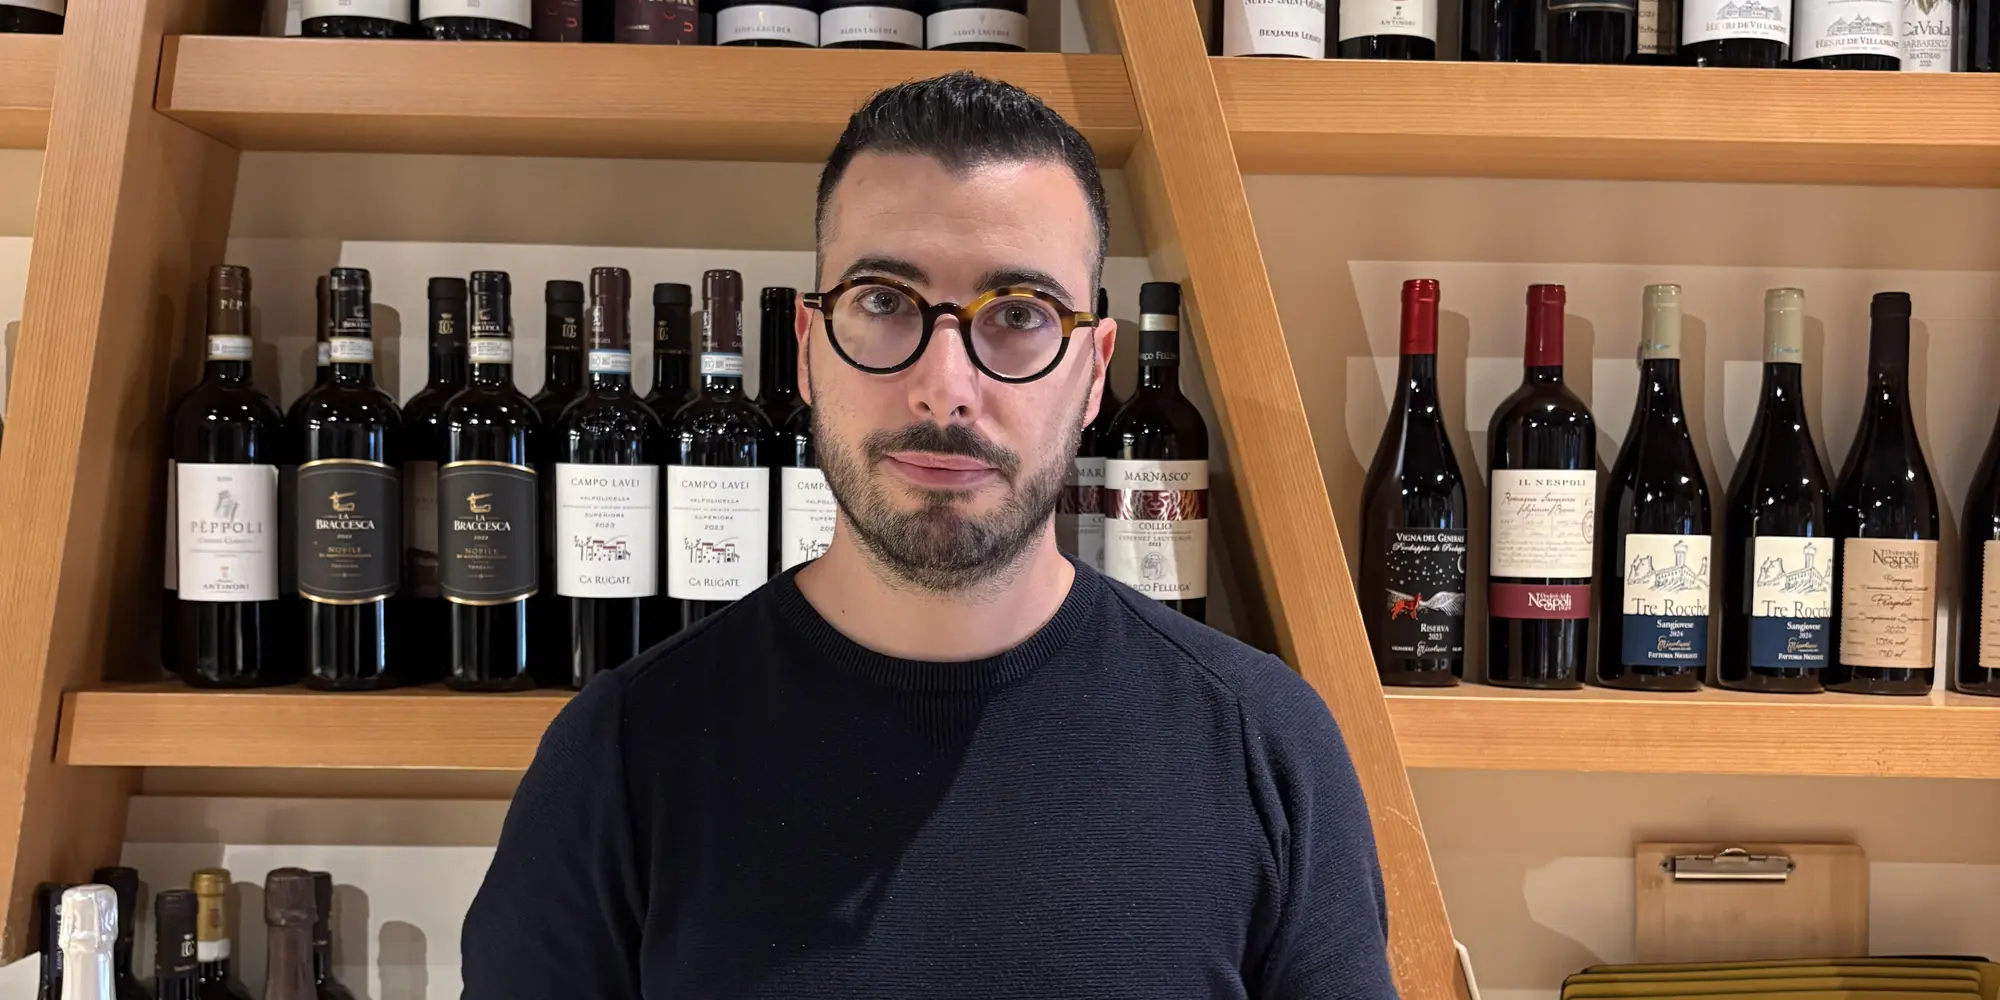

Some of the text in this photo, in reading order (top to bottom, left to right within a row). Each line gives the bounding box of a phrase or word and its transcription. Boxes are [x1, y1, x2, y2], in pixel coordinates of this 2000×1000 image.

[1259, 29, 1299, 38] BENJAMIN
[1125, 471, 1188, 483] MARNASCO
[571, 478, 640, 487] CAMPO LAVEI
[682, 480, 749, 490] CAMPO LAVEI
[1536, 479, 1586, 487] NESPOLI
[316, 519, 375, 530] BRACCESCA
[454, 520, 511, 531] BRACCESCA
[1139, 522, 1172, 530] COLLIO
[1396, 532, 1422, 542] VIGNA
[1423, 534, 1436, 542] DEL
[1872, 549, 1919, 569] Nespoli
[595, 575, 632, 584] RUGATE
[704, 578, 740, 587] RUGATE
[1153, 582, 1190, 592] FELLUGA
[1527, 592, 1572, 611] Nespoli
[1631, 597, 1657, 615] Tre
[1761, 599, 1788, 617] Tre
[1420, 623, 1449, 633] RISERVA
[1656, 619, 1694, 630] Sangiovese
